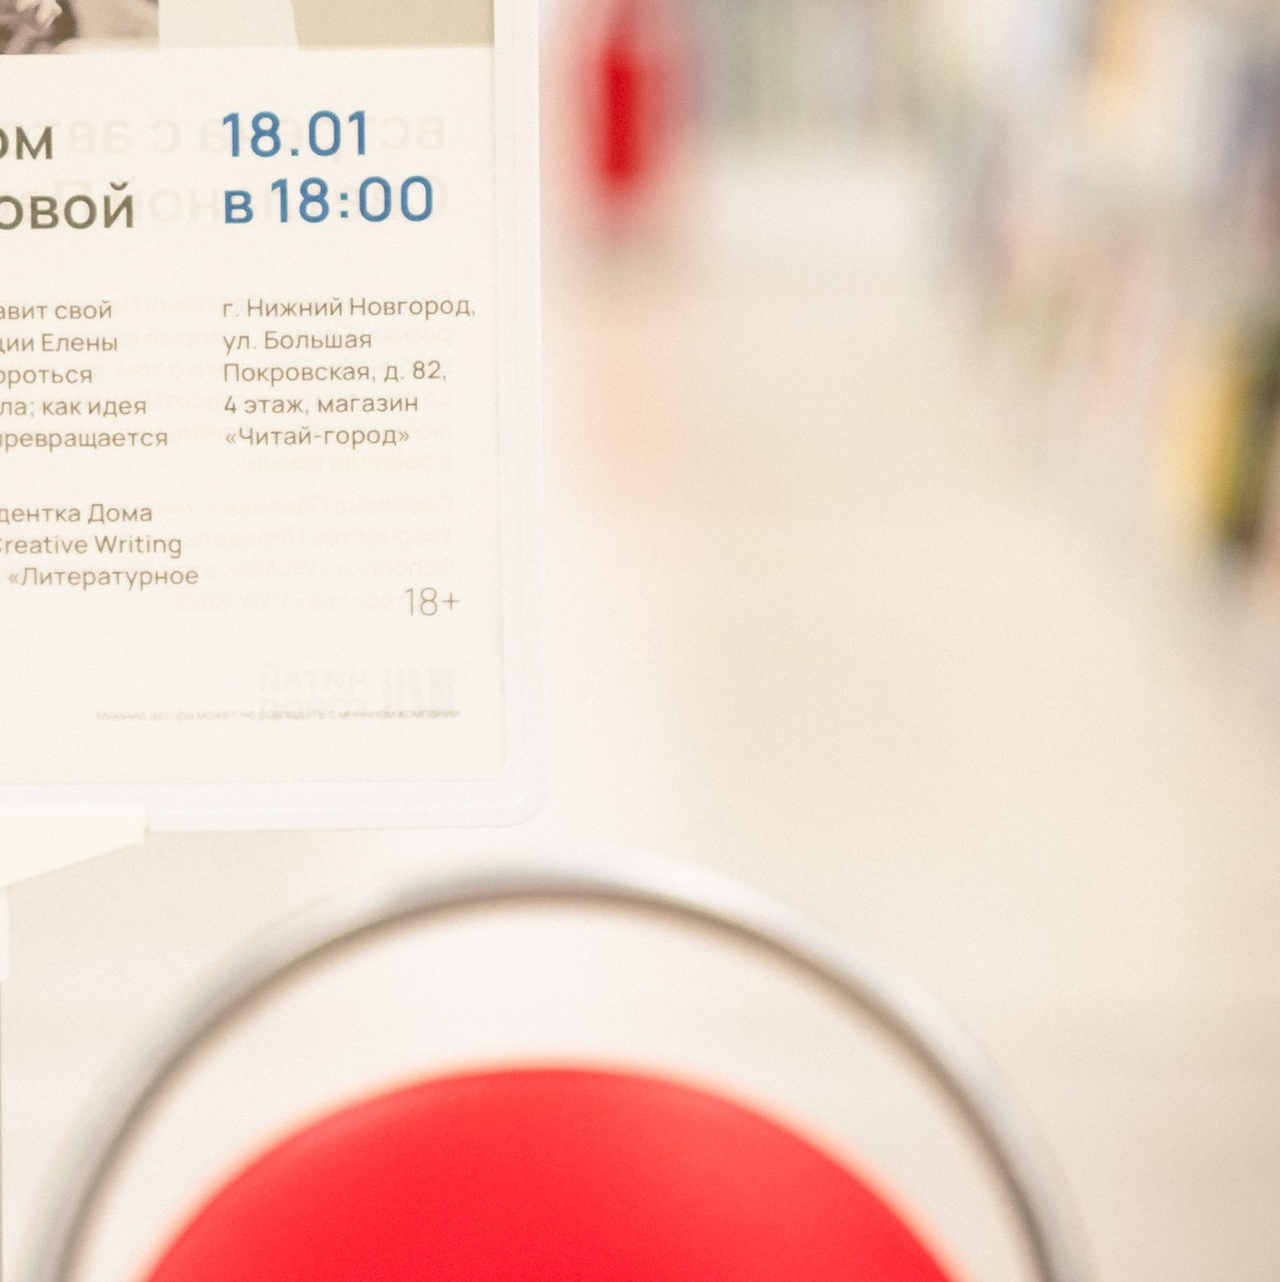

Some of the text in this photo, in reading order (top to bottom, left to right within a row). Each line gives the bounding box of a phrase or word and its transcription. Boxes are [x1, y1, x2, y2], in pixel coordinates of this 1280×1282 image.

[222, 109, 365, 158] 18.01
[224, 175, 433, 224] в 18:00
[54, 299, 112, 320] свой
[223, 296, 475, 321] г. Нижний Новгород,
[41, 332, 118, 352] Елены
[223, 330, 372, 355] ул. Большая
[223, 359, 446, 388] Покровская, д. 82,
[42, 400, 81, 416] как
[88, 400, 146, 415] идея
[224, 394, 418, 415] 4 этаж, магазин
[225, 425, 409, 451] «Читай-город»
[87, 502, 153, 521] Дома
[94, 534, 182, 559] Writing
[8, 564, 199, 590] «Литературное
[405, 587, 459, 616] 18+
